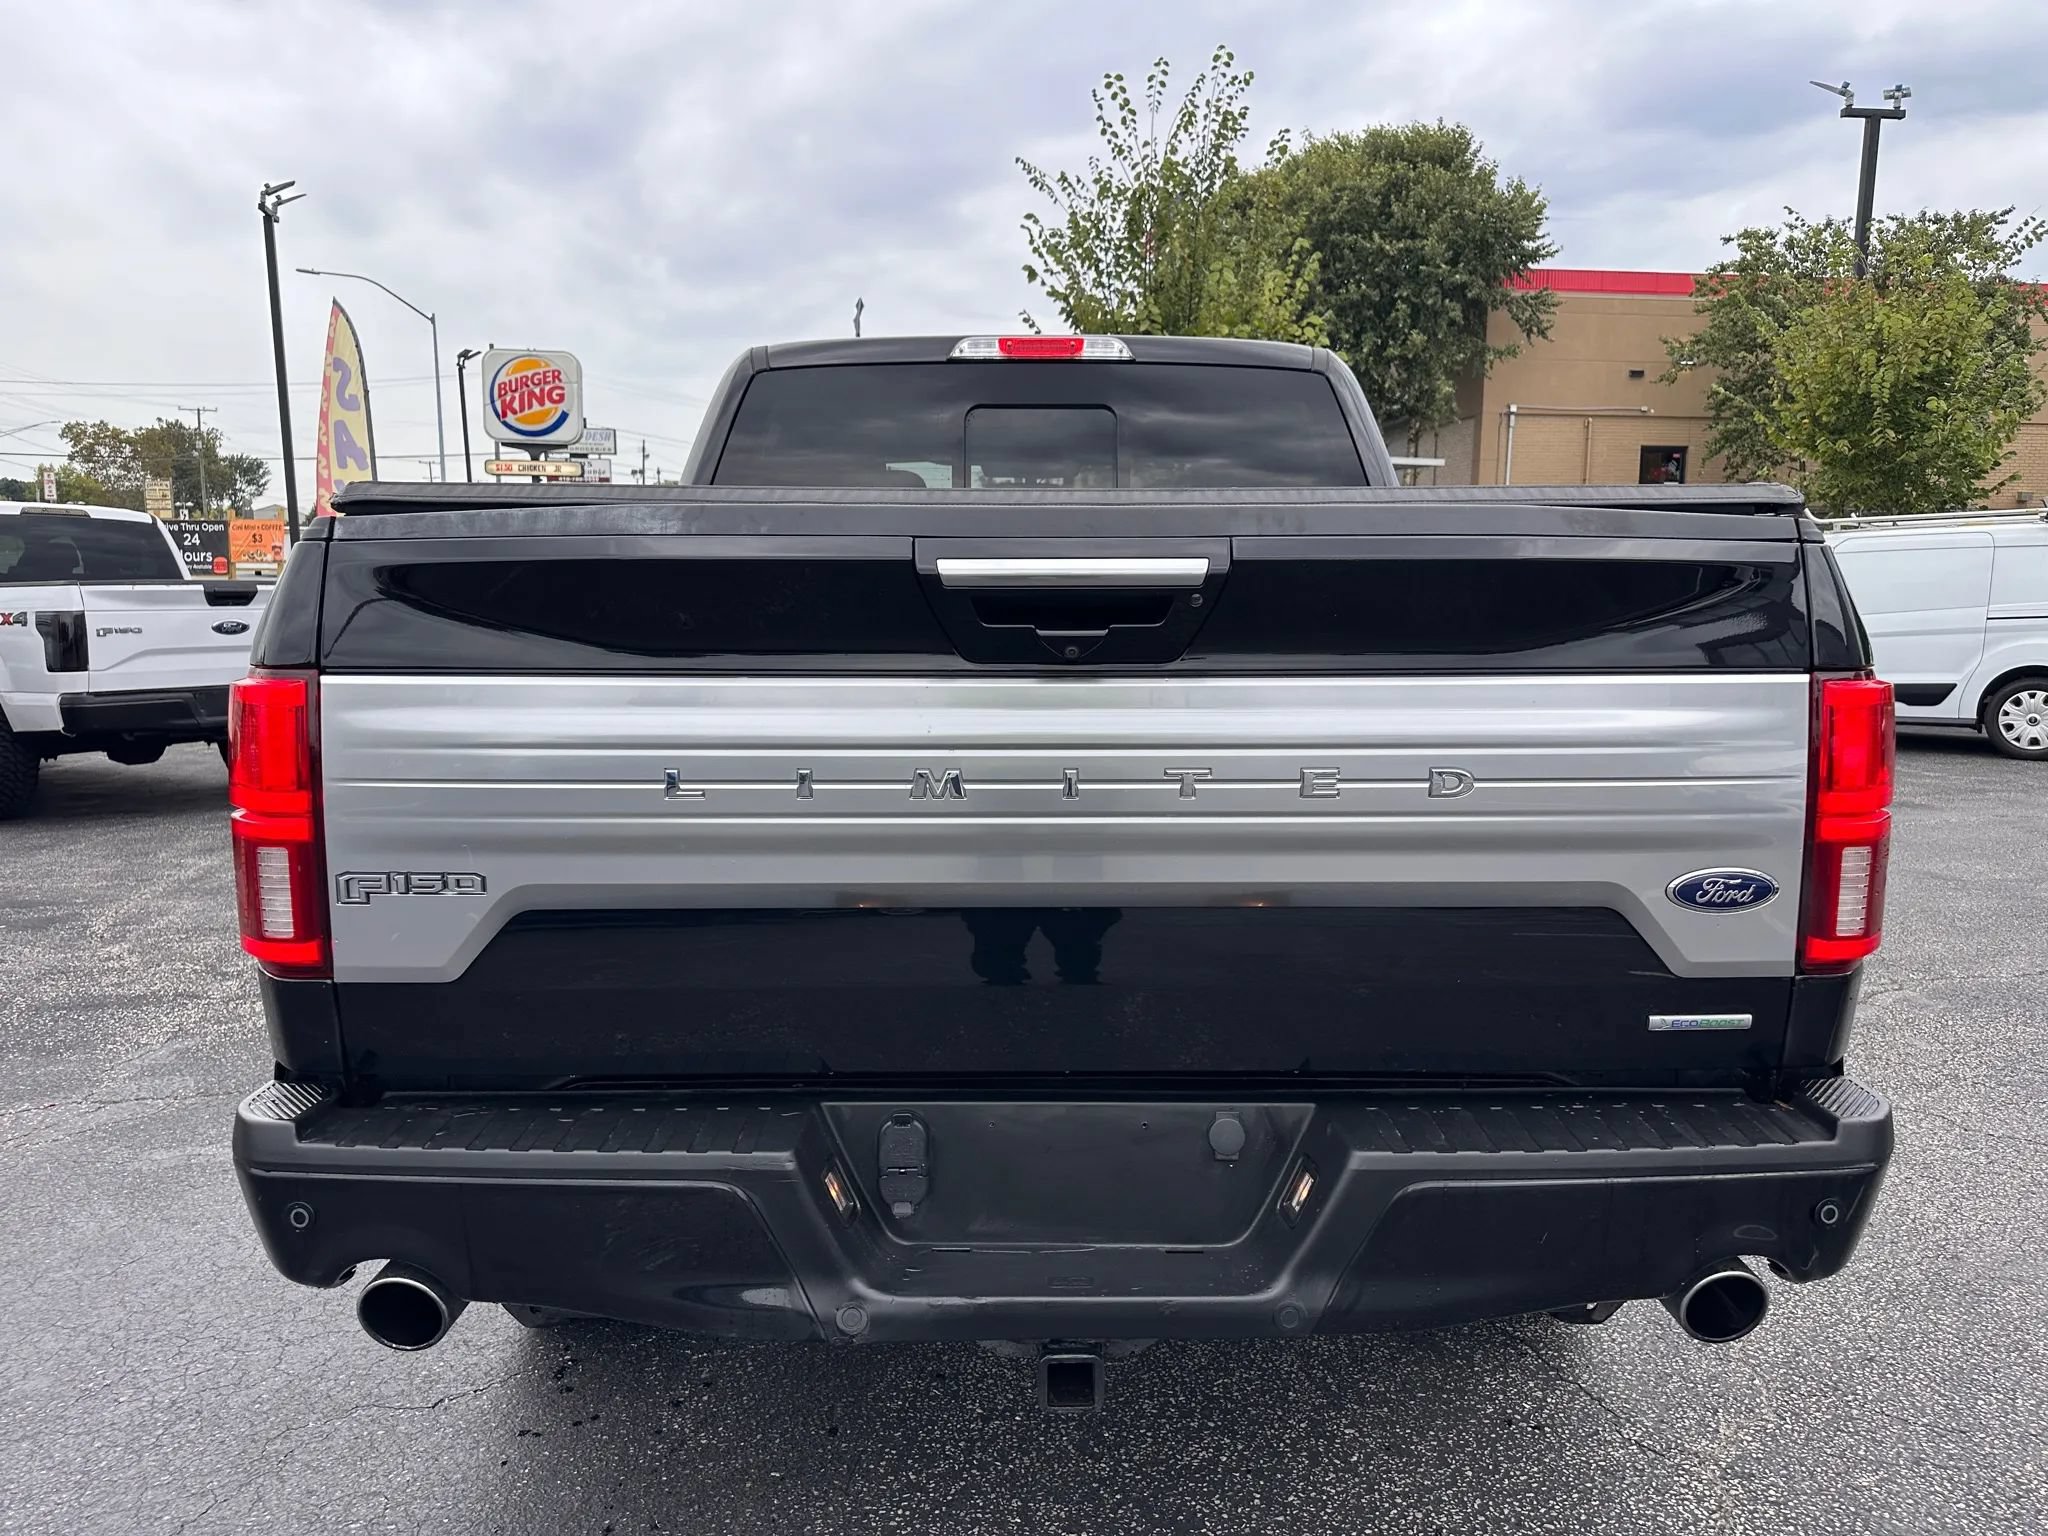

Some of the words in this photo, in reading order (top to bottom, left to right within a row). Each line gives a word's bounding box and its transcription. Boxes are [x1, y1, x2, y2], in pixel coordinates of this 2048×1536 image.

[497, 369, 562, 399] BURGER
[500, 386, 565, 420] KING
[518, 464, 546, 472] CHICKEN
[181, 522, 200, 531] Thru
[202, 522, 225, 532] Open
[183, 533, 200, 546] 24
[252, 533, 263, 544] $3
[664, 766, 1475, 800] LIMITED
[1695, 877, 1756, 903] Ford
